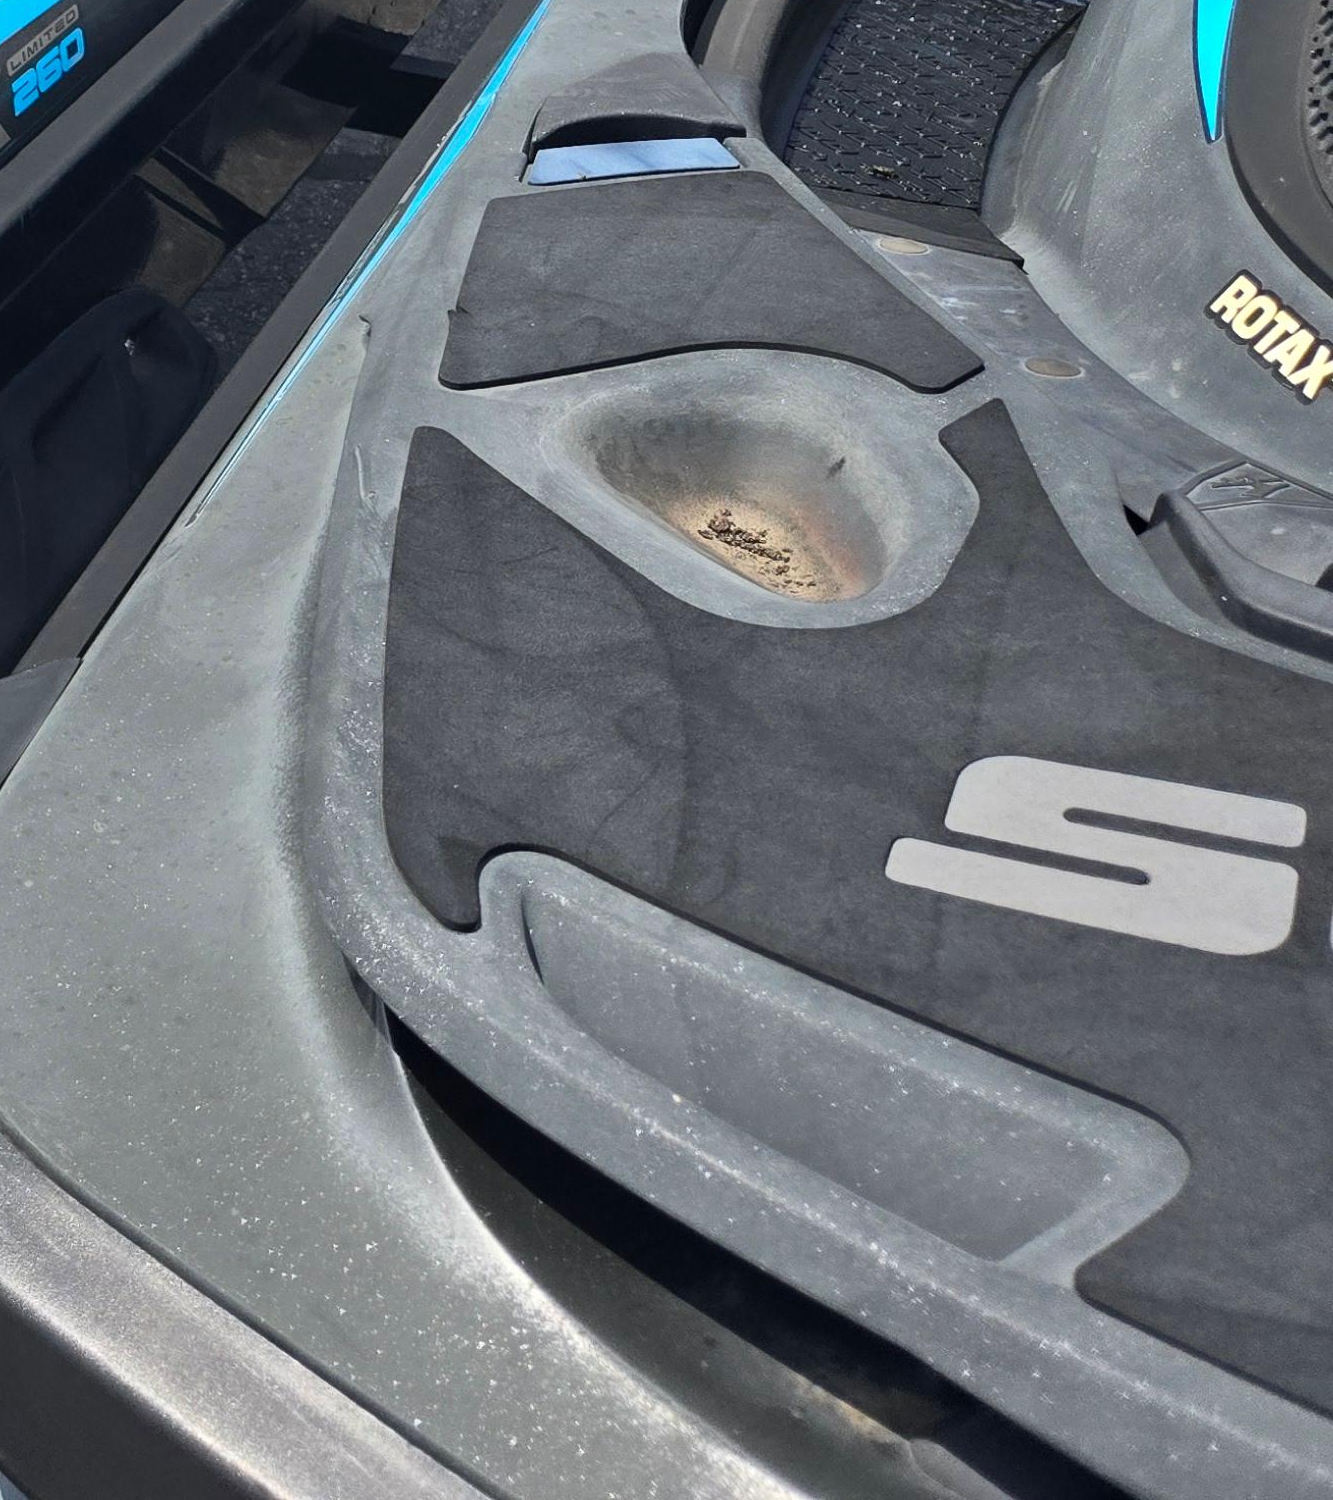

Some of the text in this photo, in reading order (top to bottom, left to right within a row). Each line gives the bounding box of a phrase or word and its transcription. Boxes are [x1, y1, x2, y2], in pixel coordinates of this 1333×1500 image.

[8, 6, 78, 74] LIMITED
[11, 27, 85, 117] 260
[1209, 274, 1333, 400] ROTAX
[885, 755, 1333, 956] S
